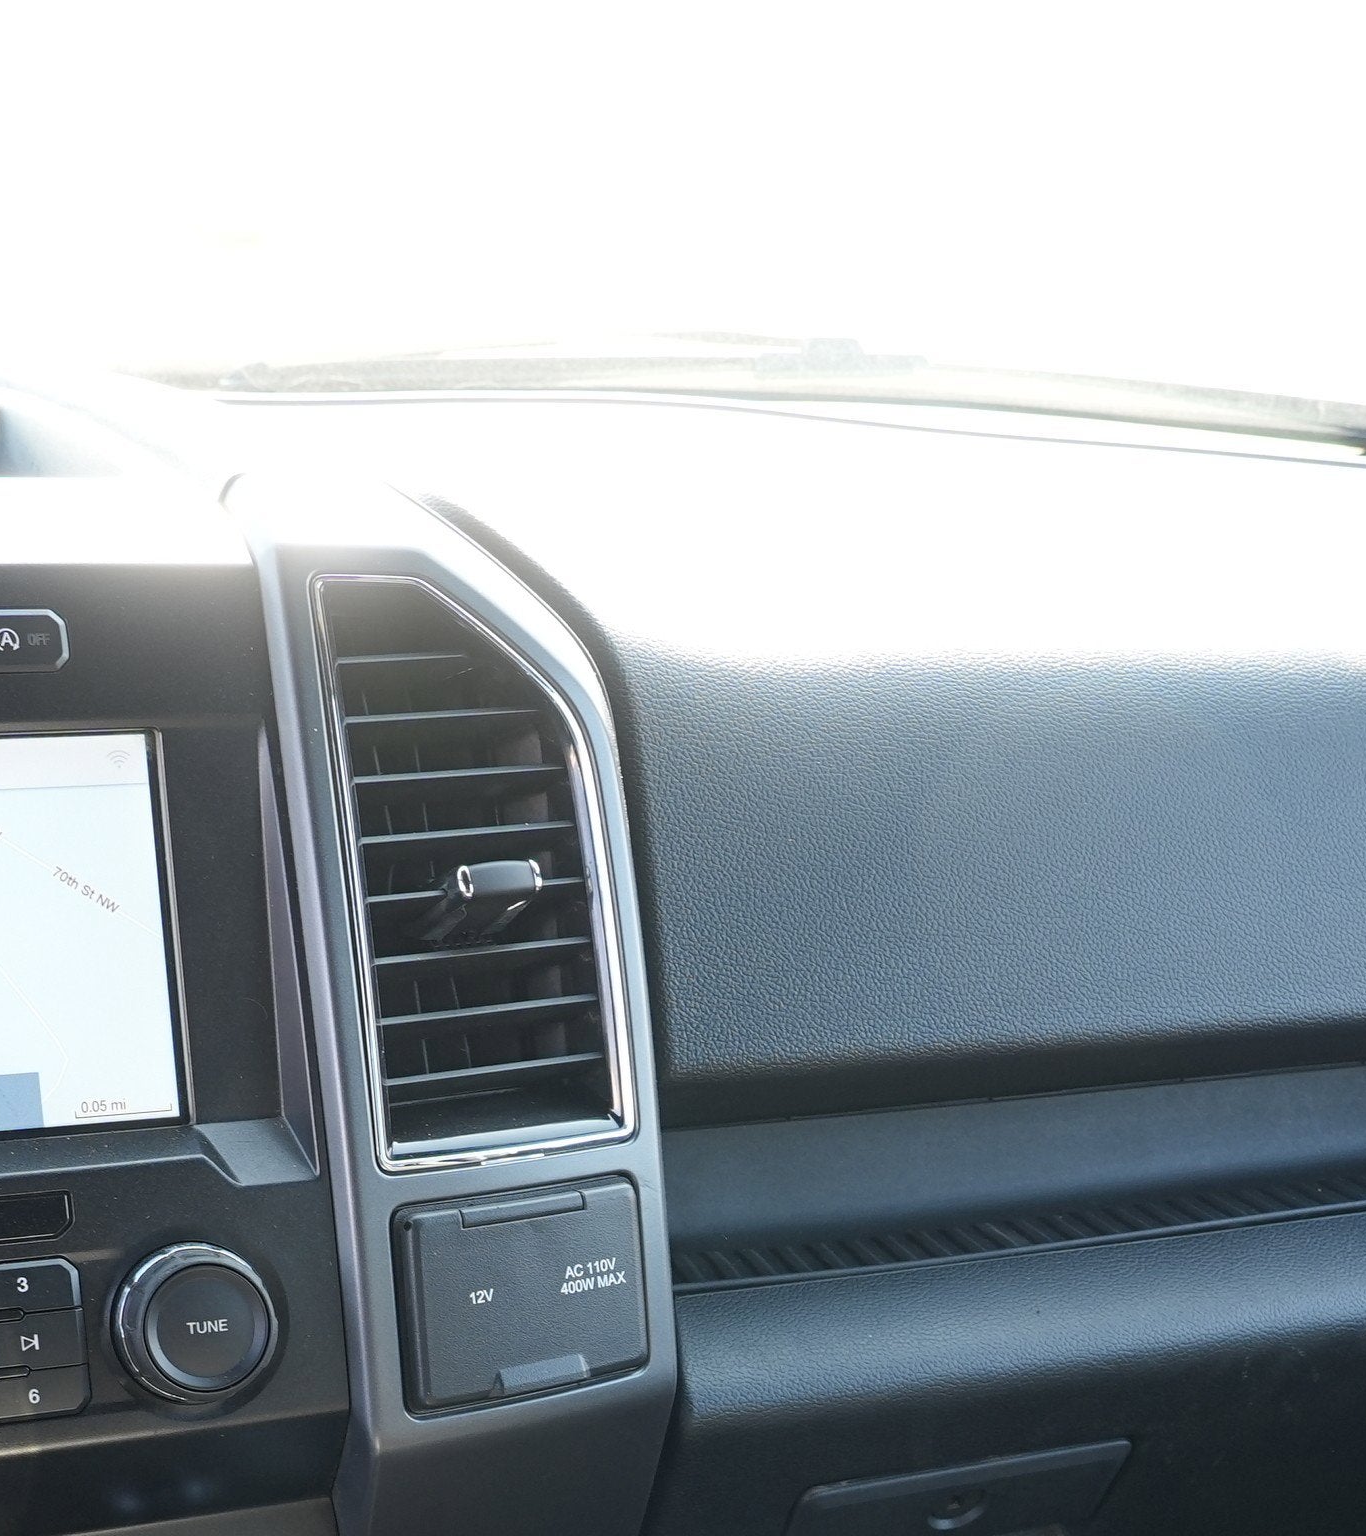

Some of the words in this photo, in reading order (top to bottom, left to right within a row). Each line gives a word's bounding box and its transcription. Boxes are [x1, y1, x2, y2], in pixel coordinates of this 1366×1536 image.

[52, 866, 79, 890] 70th
[81, 884, 95, 900] St
[96, 894, 120, 913] NW
[81, 1100, 108, 1114] 0.05
[110, 1099, 127, 1112] mi
[565, 1263, 585, 1280] AC
[587, 1257, 617, 1276] 110V
[16, 1276, 29, 1293] 3
[560, 1277, 595, 1295] 400W
[596, 1270, 627, 1289] MAX
[468, 1288, 494, 1305] 12V
[186, 1319, 229, 1335] TUNE
[28, 1388, 41, 1404] 6
